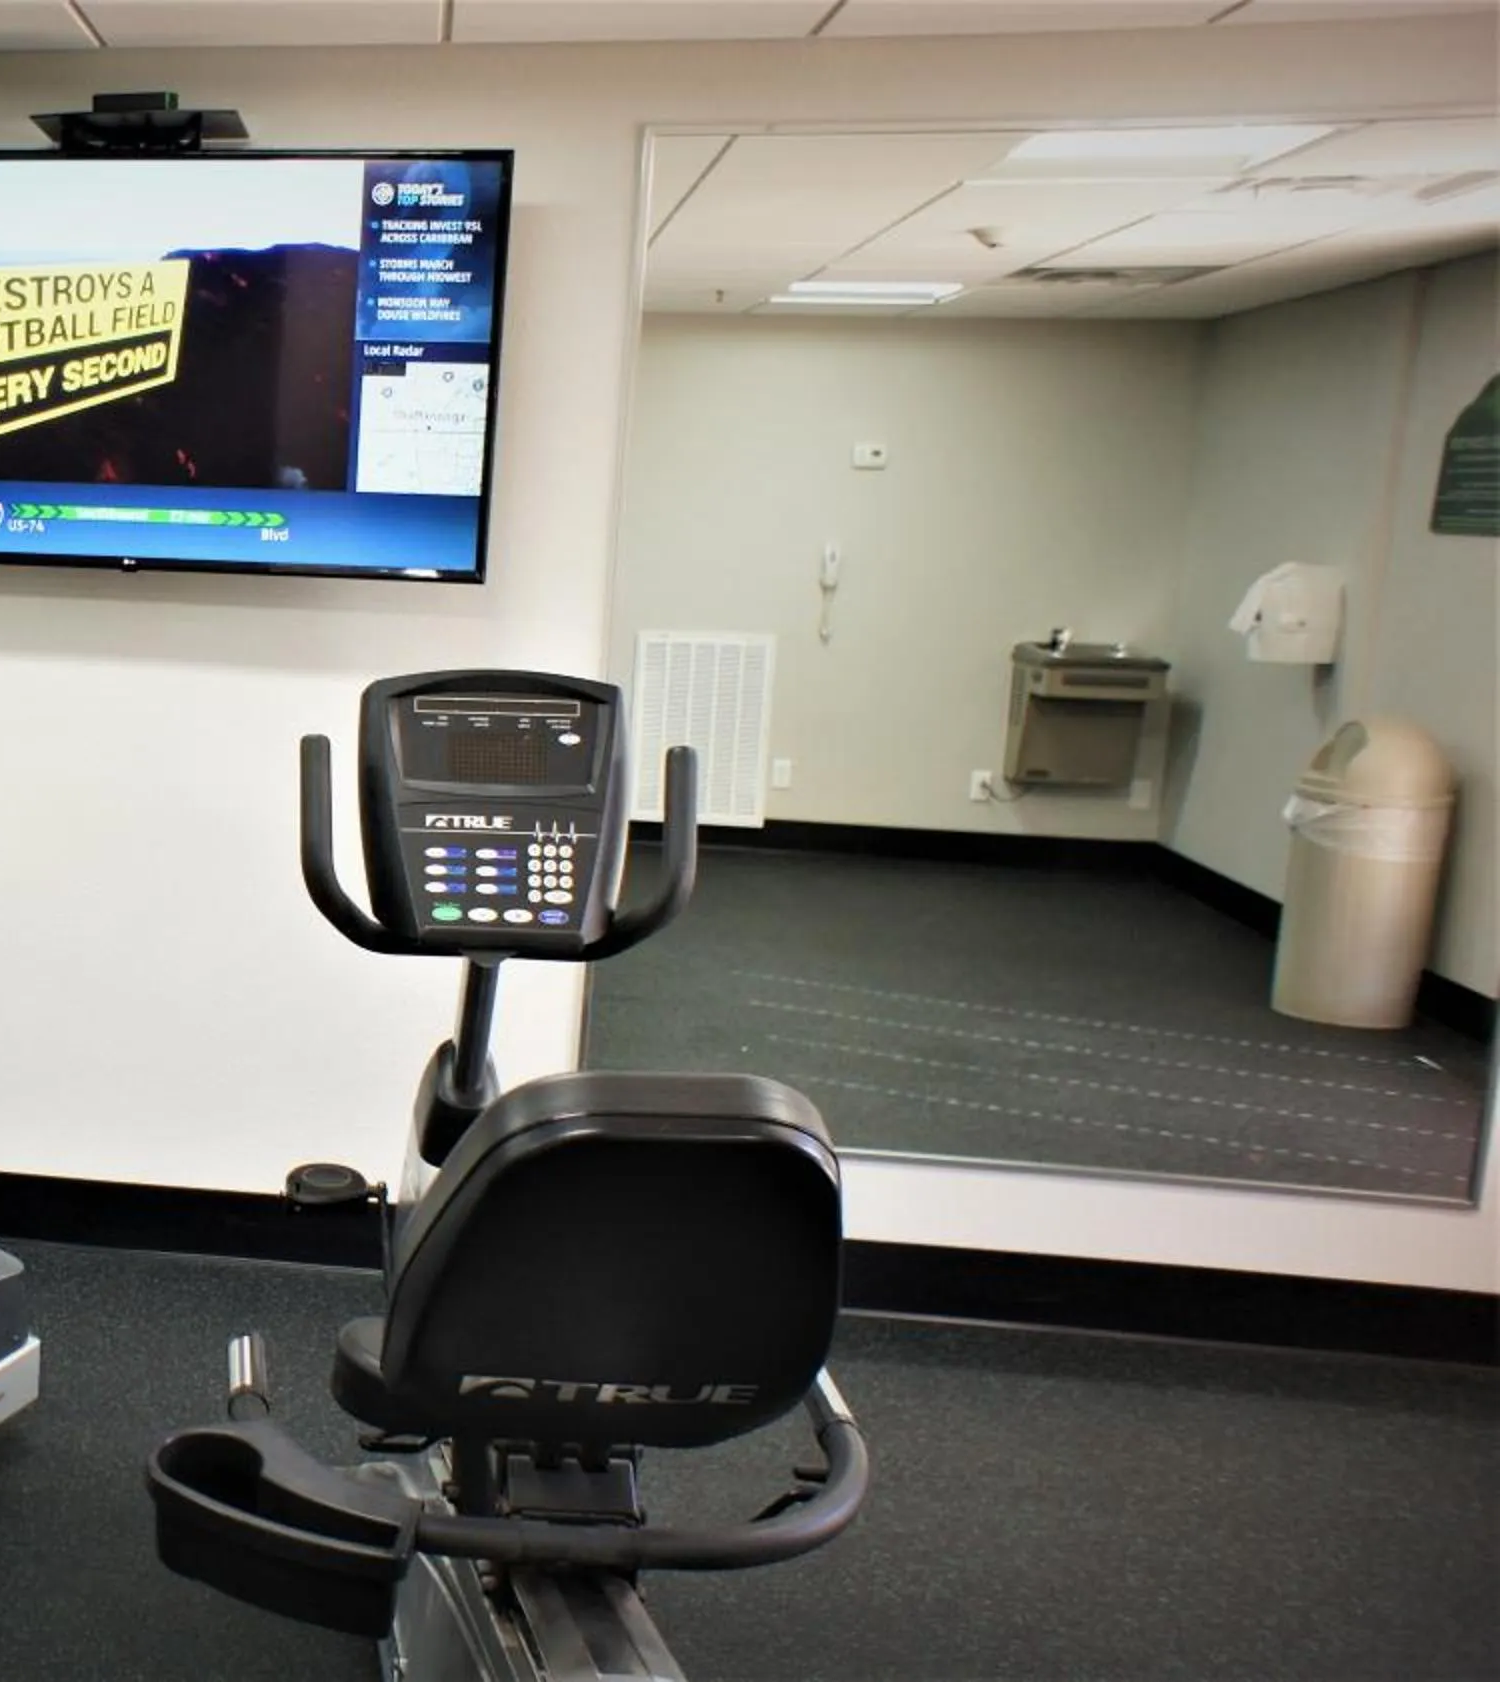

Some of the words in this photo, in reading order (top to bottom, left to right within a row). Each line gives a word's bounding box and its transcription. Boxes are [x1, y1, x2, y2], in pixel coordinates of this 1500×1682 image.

[397, 194, 419, 206] TOP
[380, 232, 418, 243] ACROSS
[139, 272, 155, 297] A
[111, 301, 176, 333] FIELD
[363, 344, 391, 357] Local
[393, 345, 425, 357] Radar
[61, 341, 168, 393] SECOND
[260, 527, 290, 542] Blvd
[449, 815, 514, 829] TRUE
[541, 1379, 760, 1405] TRUE
